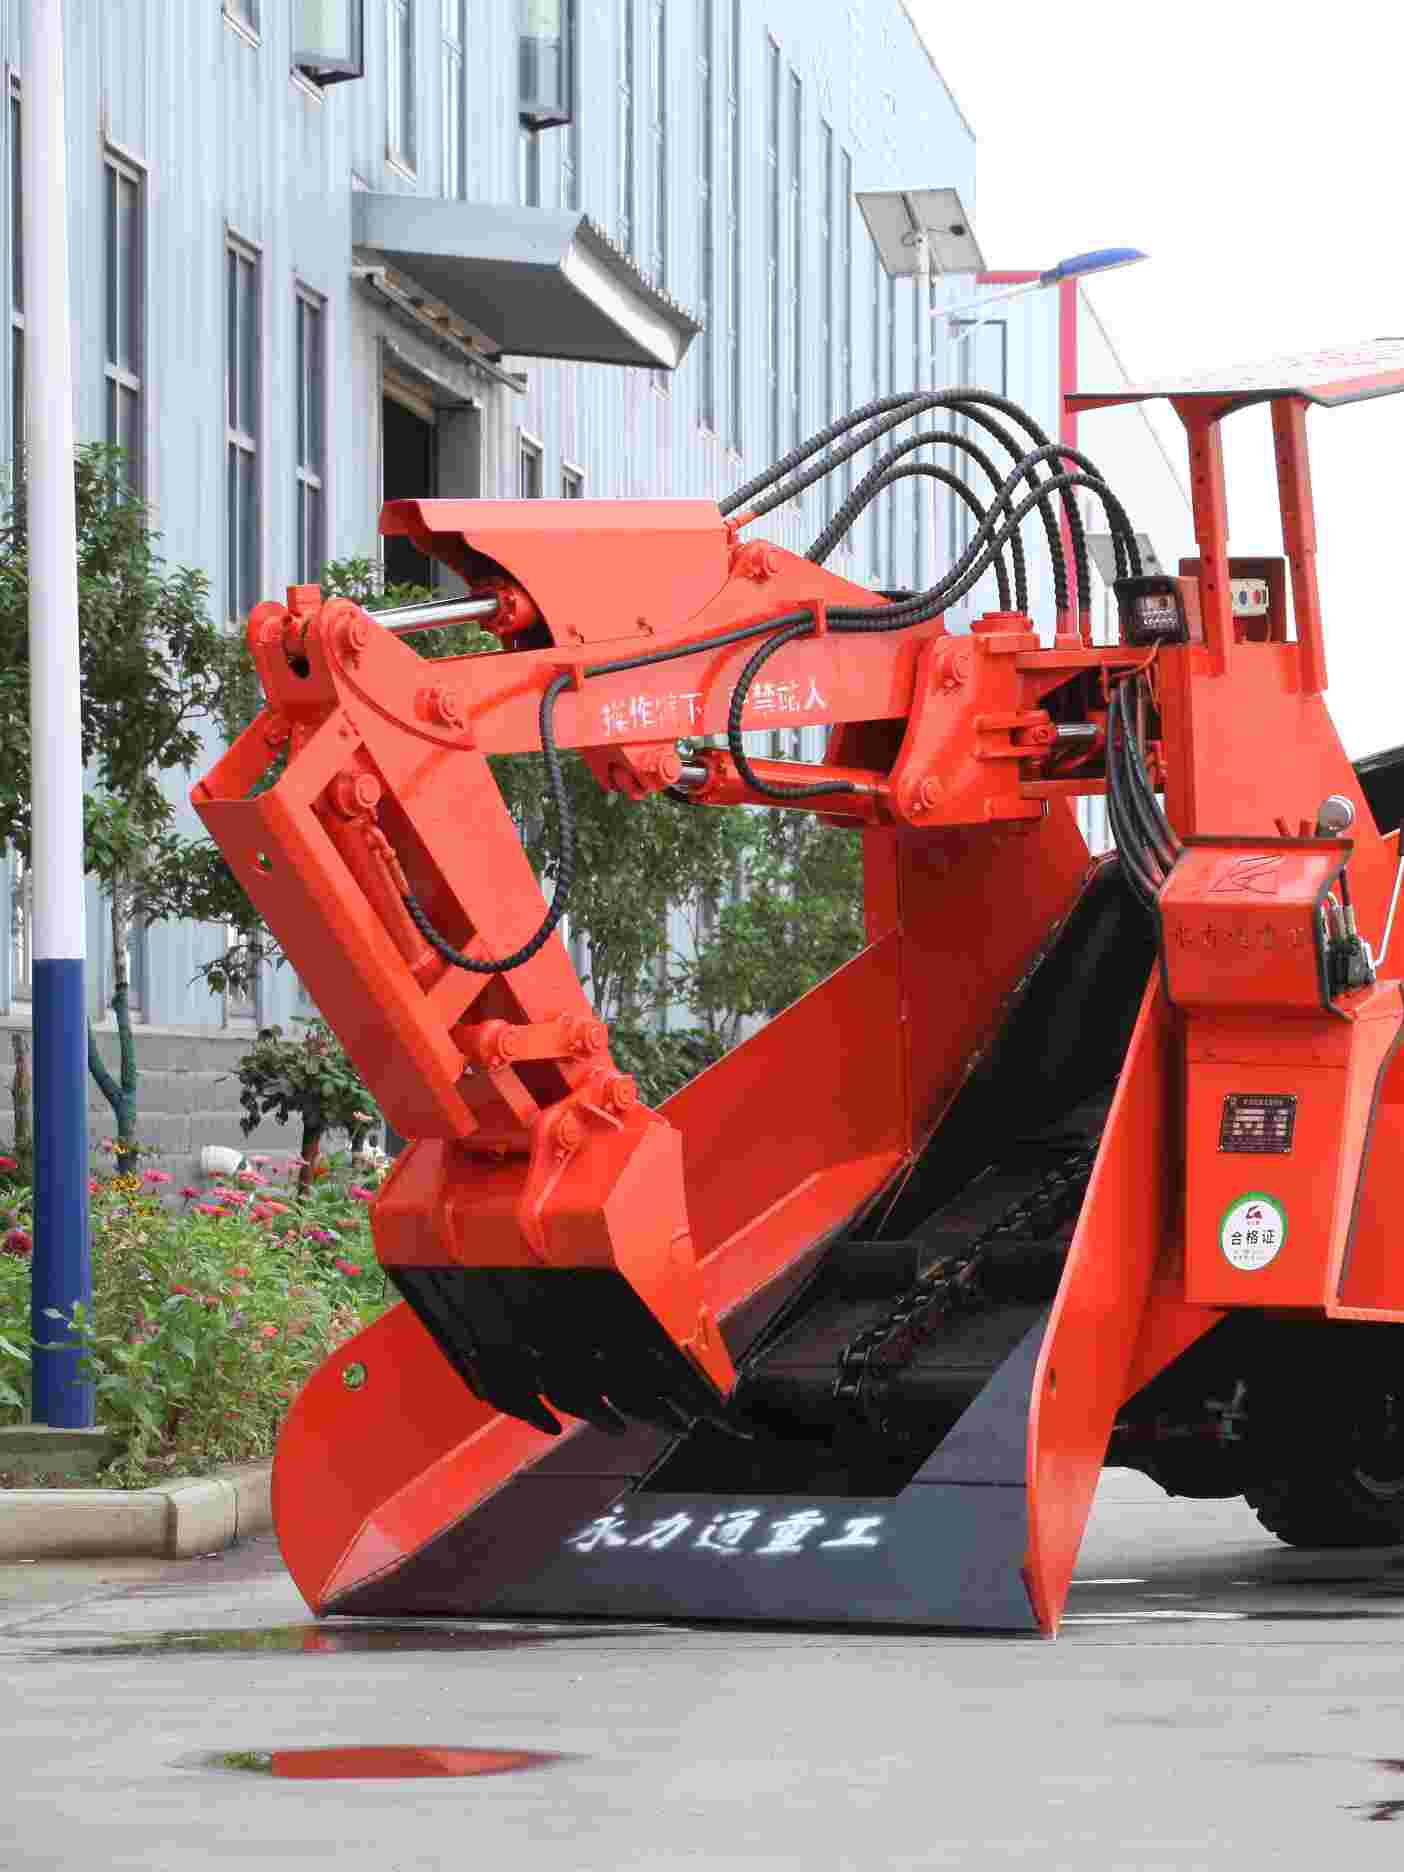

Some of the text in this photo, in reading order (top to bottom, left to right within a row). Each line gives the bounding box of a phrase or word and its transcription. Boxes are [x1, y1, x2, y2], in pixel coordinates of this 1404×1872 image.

[1231, 1229, 1275, 1245] 合格证
[566, 1505, 884, 1553] 永力通重工
